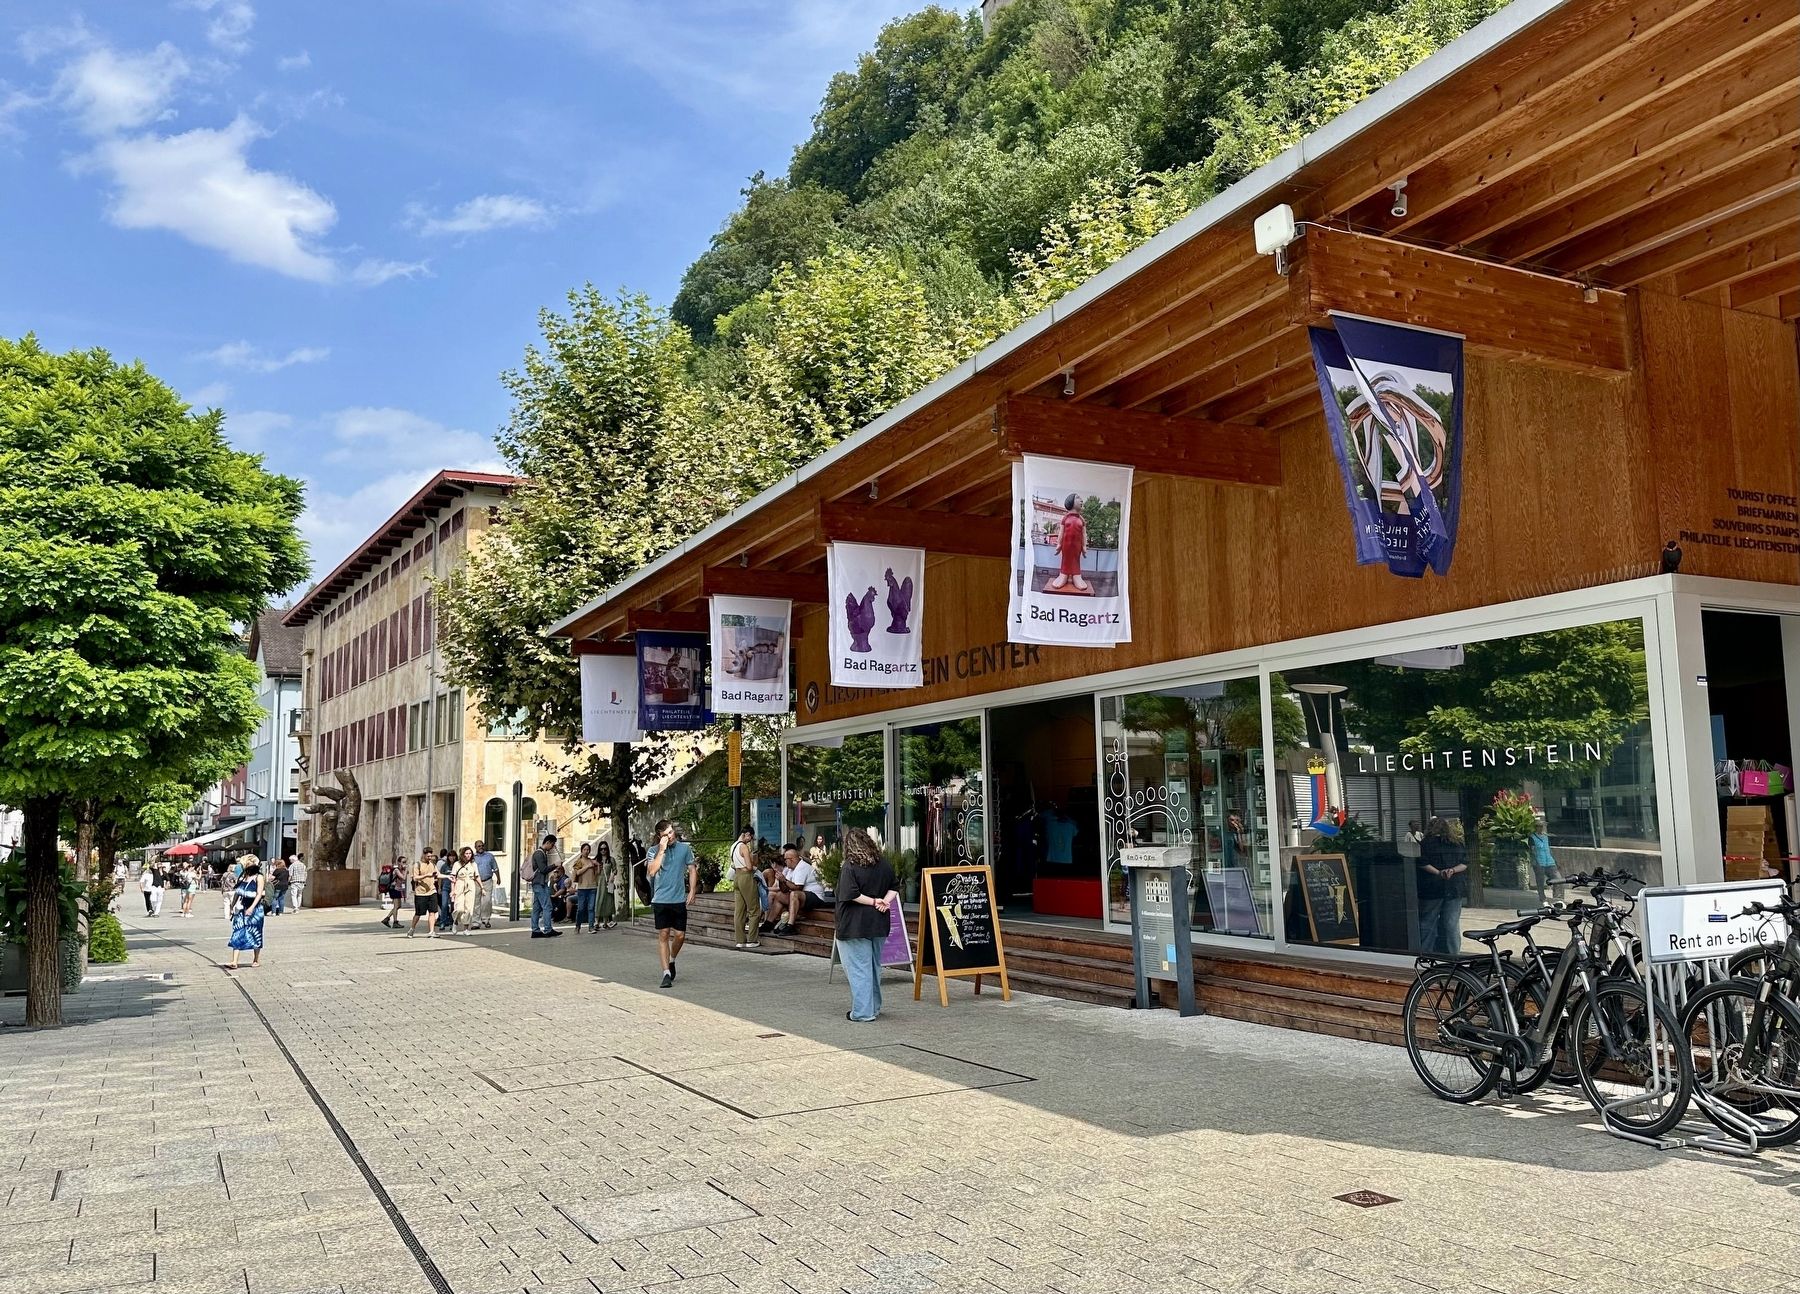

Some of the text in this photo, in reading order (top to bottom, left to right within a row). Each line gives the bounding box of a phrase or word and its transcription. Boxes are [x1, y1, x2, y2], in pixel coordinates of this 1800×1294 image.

[1727, 488, 1798, 507] TOURIST OFFICE
[1737, 505, 1799, 523] BRIEFMARKEN
[1680, 530, 1731, 547] PHILATELIE
[1713, 519, 1800, 539] SOUVENIRS STAMPS
[1030, 605, 1055, 623] Bad
[1058, 609, 1120, 627] Ragartz
[844, 658, 917, 674] Bad Ragartz
[955, 641, 1040, 679] CENTER
[721, 690, 784, 703] Bad Ragartz
[1358, 741, 1603, 774] LIECHTENSTEIN
[1670, 926, 1768, 951] Rent an e-bike
